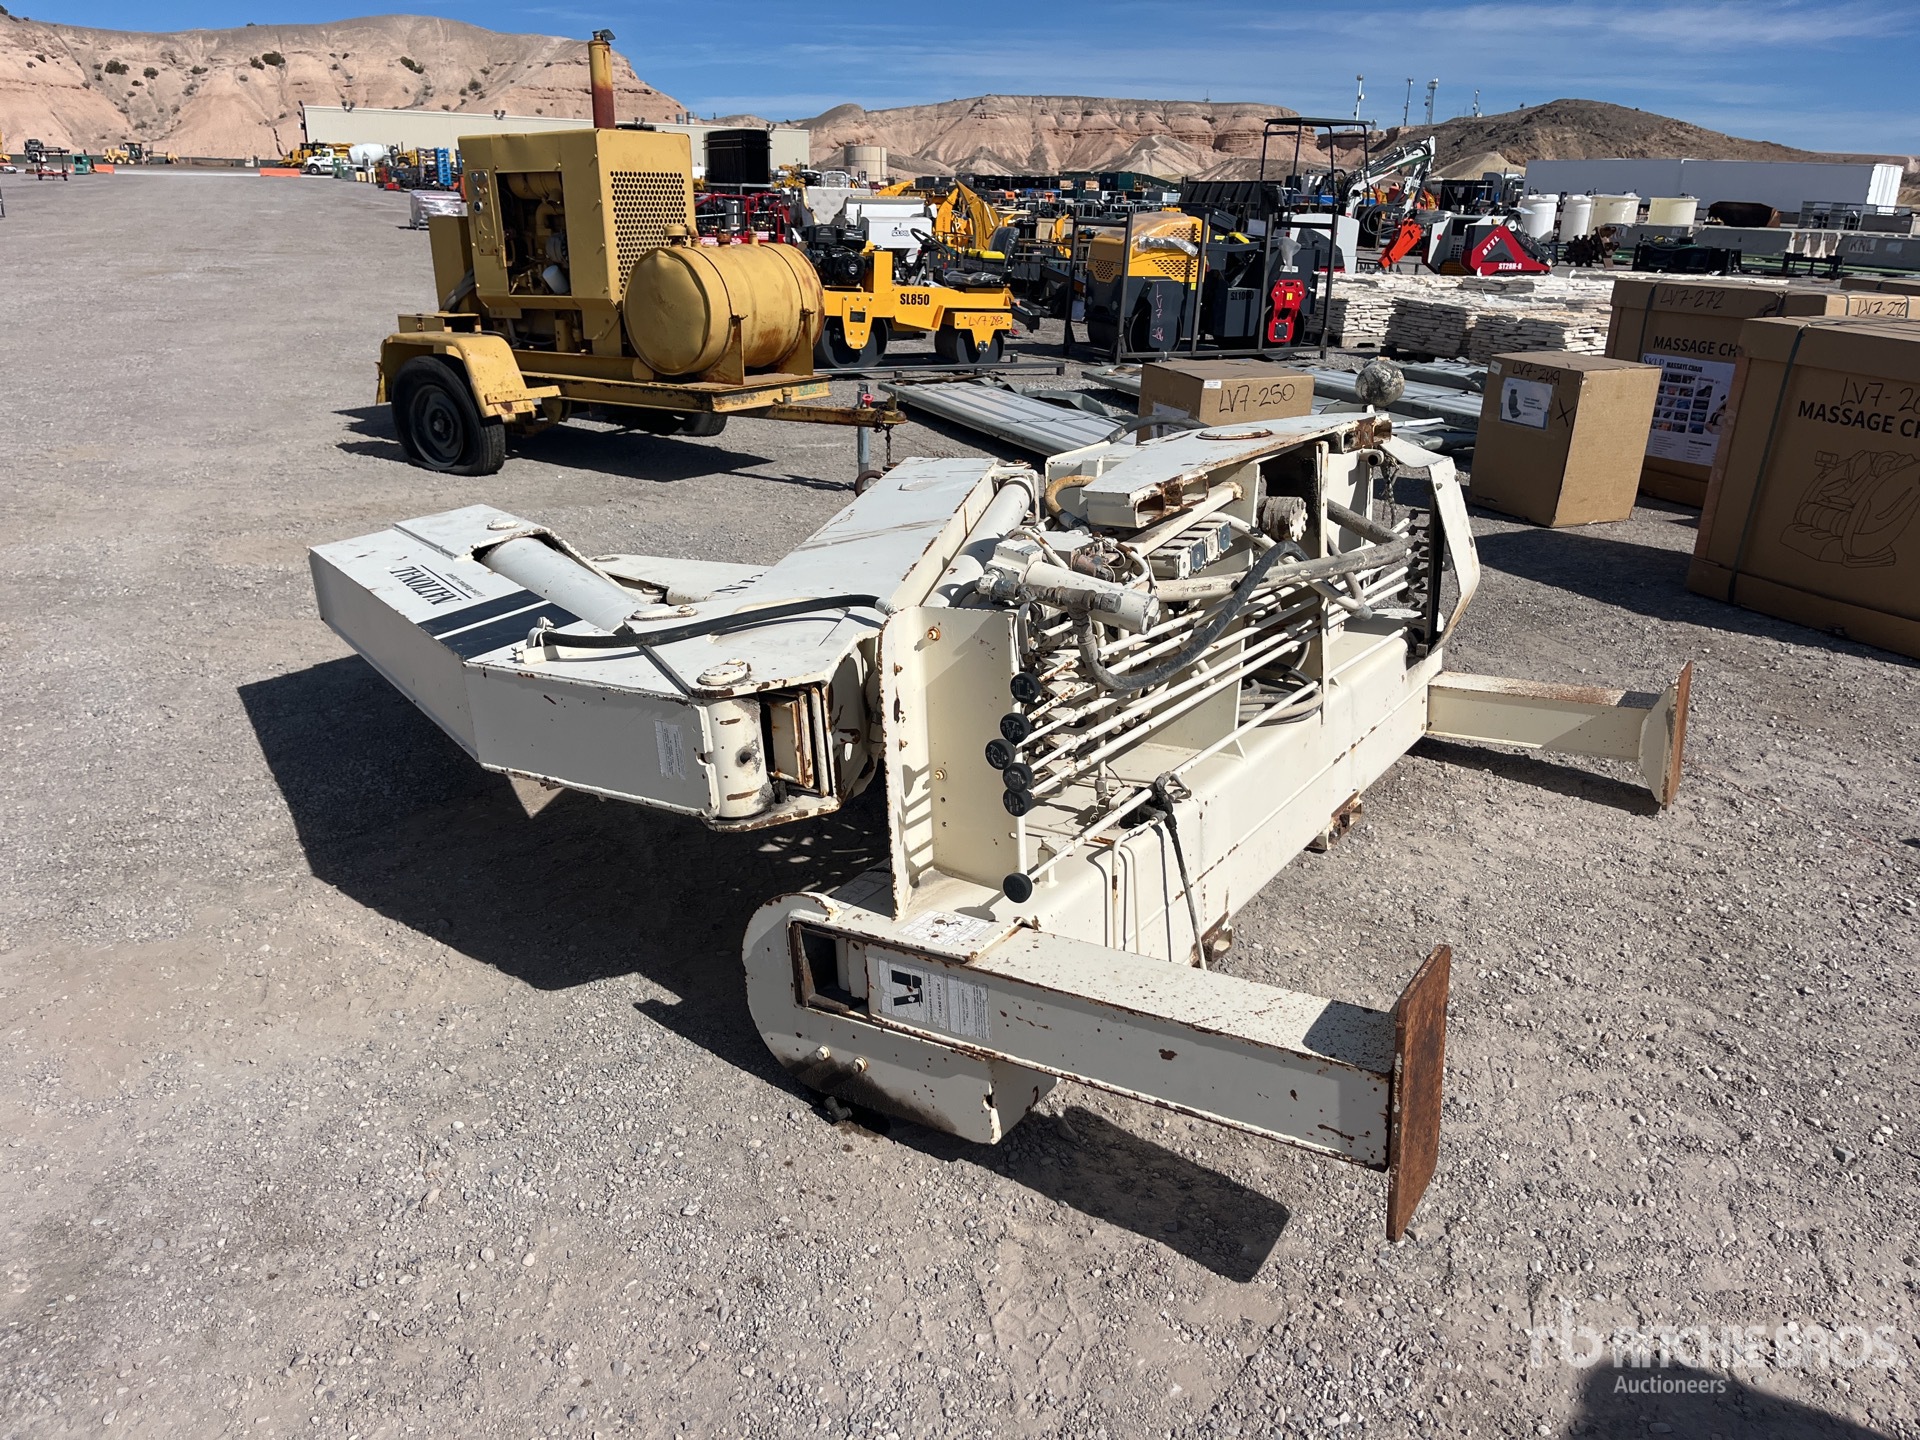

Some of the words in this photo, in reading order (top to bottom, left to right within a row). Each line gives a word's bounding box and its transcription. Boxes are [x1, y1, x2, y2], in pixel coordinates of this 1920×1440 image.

[900, 293, 930, 306] SL850
[1660, 287, 1725, 310] LV7-272
[1653, 335, 1716, 355] MASSAGE
[1512, 361, 1561, 386] LV7-249
[1219, 383, 1295, 413] LV7-250
[1798, 400, 1895, 434] MASSAGE
[389, 565, 463, 605] NATIONAL
